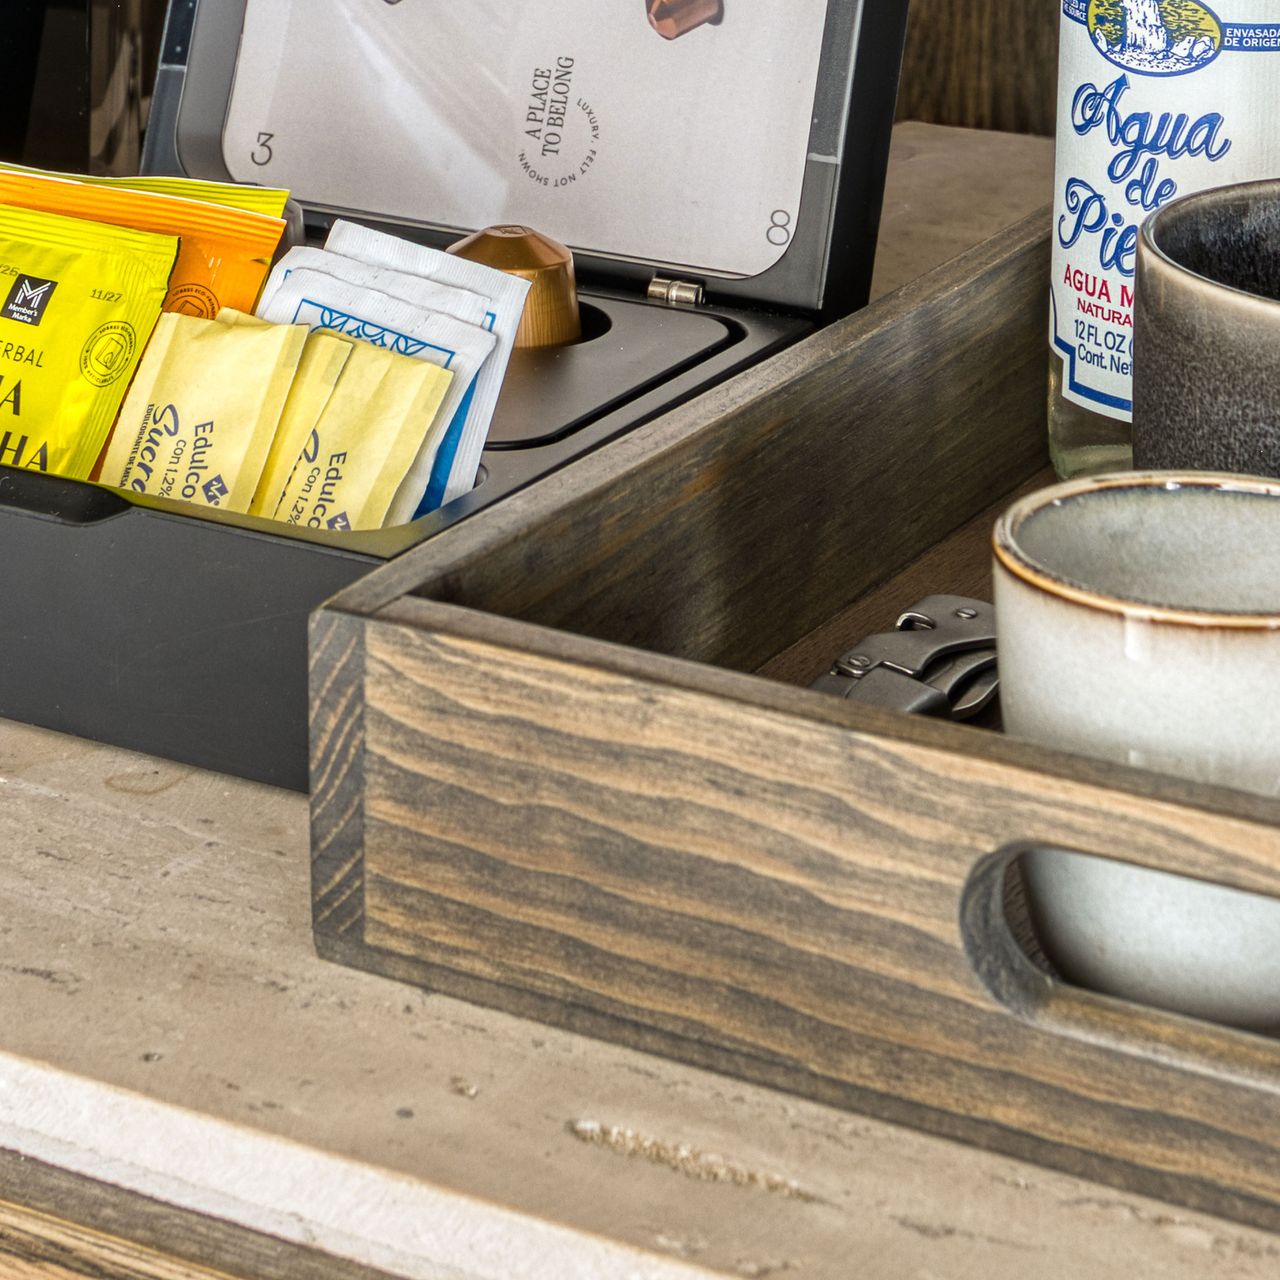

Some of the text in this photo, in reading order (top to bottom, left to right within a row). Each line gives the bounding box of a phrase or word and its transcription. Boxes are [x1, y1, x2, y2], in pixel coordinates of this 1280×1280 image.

[1225, 37, 1239, 47] DE
[525, 67, 552, 140] A PLACE
[541, 56, 574, 157] TO BELONG
[1071, 72, 1232, 183] Agua
[250, 132, 275, 166] 3
[580, 149, 597, 175] FELT
[553, 173, 576, 187] NOT
[1125, 158, 1177, 212] de
[766, 209, 791, 246] 8
[1058, 177, 1138, 277] Pie
[90, 287, 122, 303] 11/27
[1063, 264, 1111, 304] AGUA
[1077, 297, 1133, 328] NATURA
[1074, 318, 1086, 339] 12
[1087, 325, 1103, 346] FL
[1104, 331, 1126, 354] OZ
[1077, 343, 1108, 371] Cont.
[169, 440, 186, 464] con
[181, 420, 214, 499] Edulco
[302, 467, 320, 493] con
[307, 451, 347, 529] Edulco
